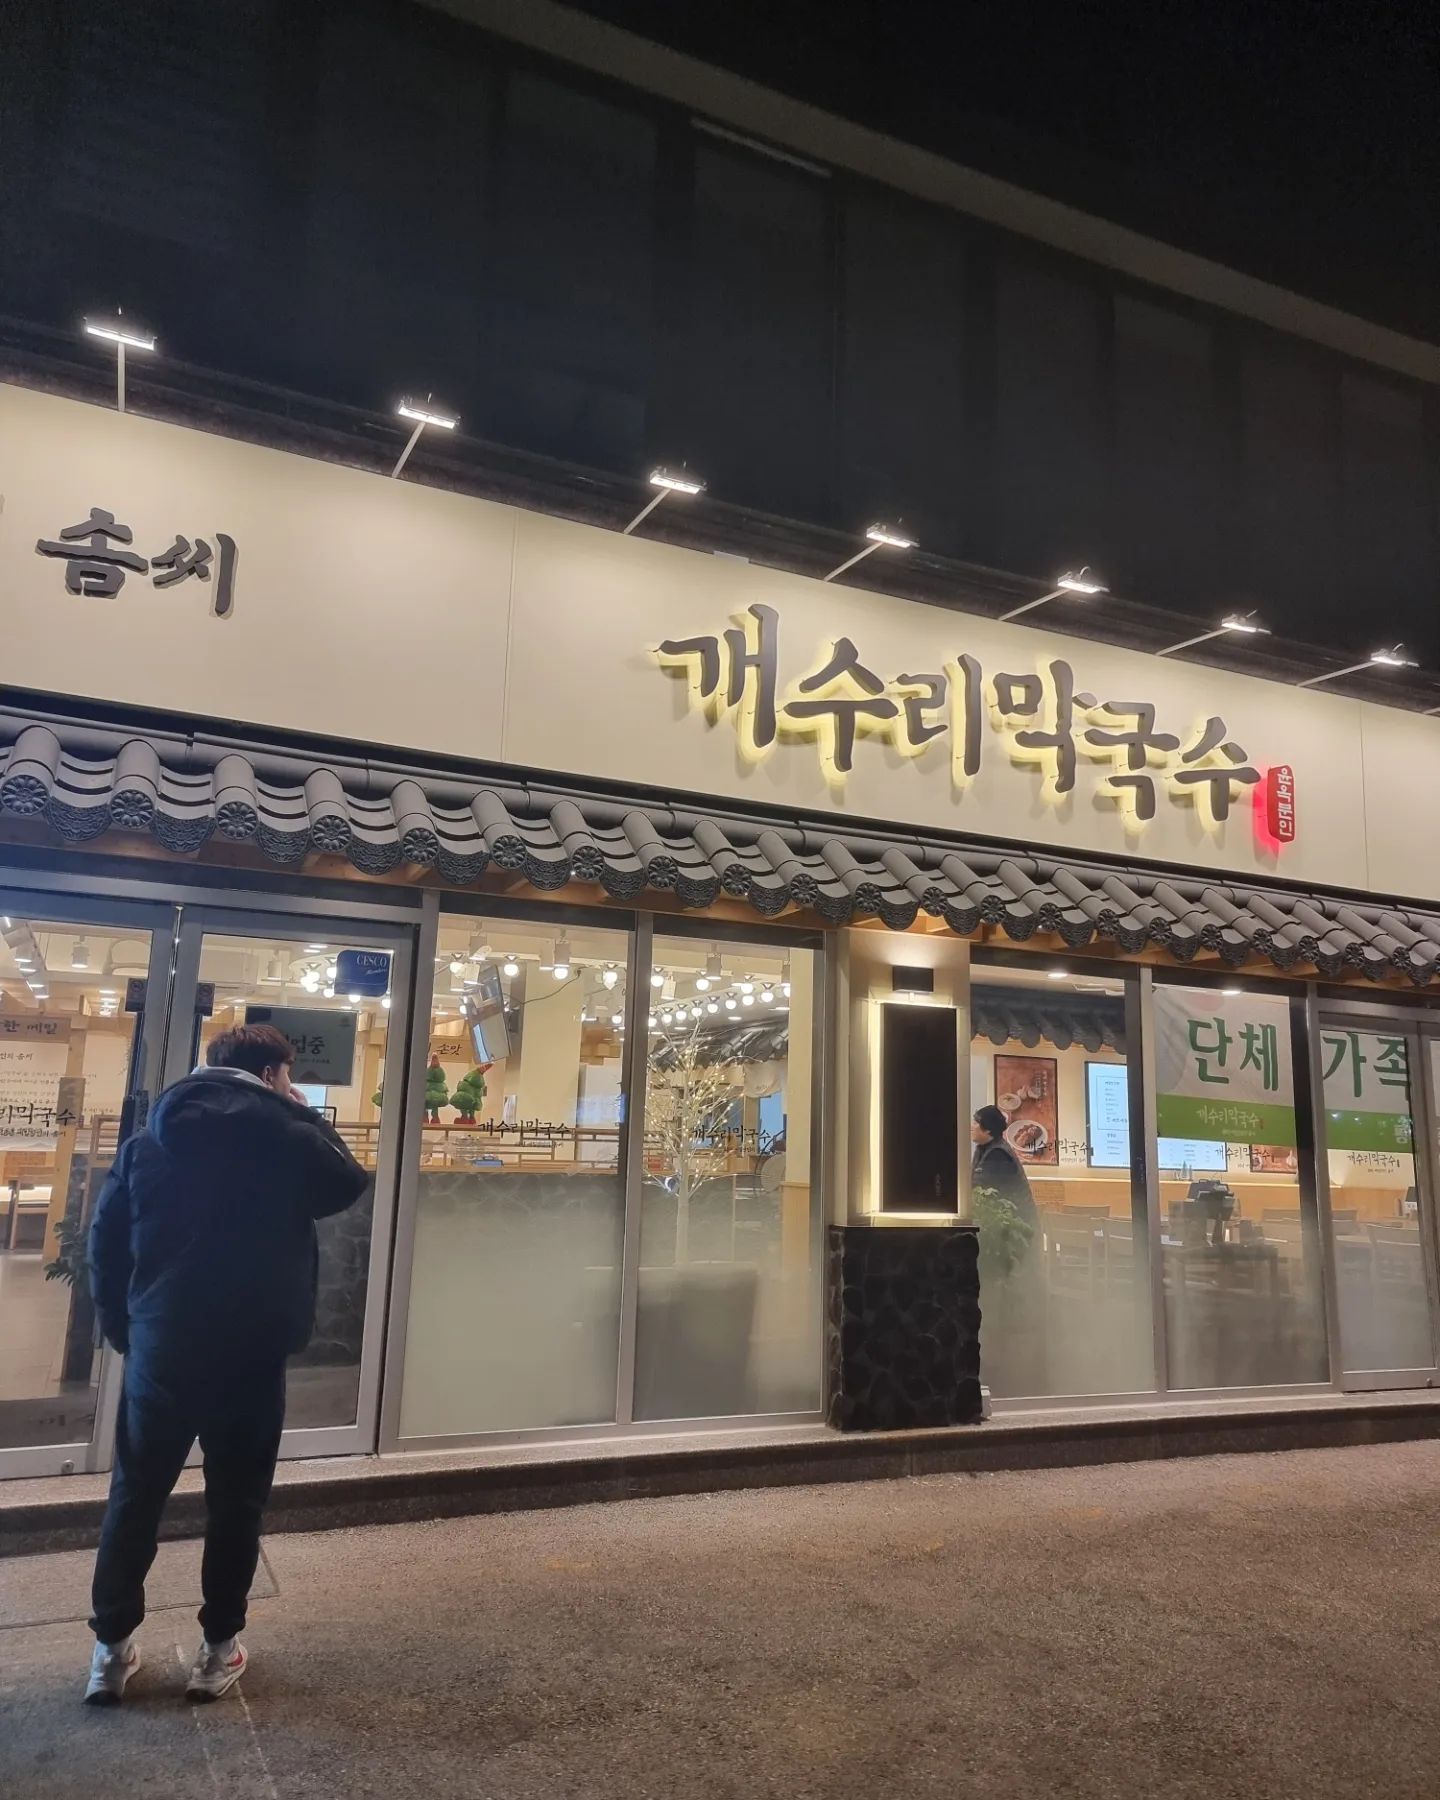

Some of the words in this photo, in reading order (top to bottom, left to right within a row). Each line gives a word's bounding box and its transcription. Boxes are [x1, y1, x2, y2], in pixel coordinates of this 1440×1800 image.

[36, 507, 237, 617] 솜씨
[657, 602, 1262, 823] 개수리막국수
[356, 954, 388, 968] CESCO
[286, 1034, 326, 1056] 업중
[436, 1043, 463, 1056] 손맛
[1187, 1017, 1279, 1092] 단체
[478, 1117, 571, 1140] 개수리막국수
